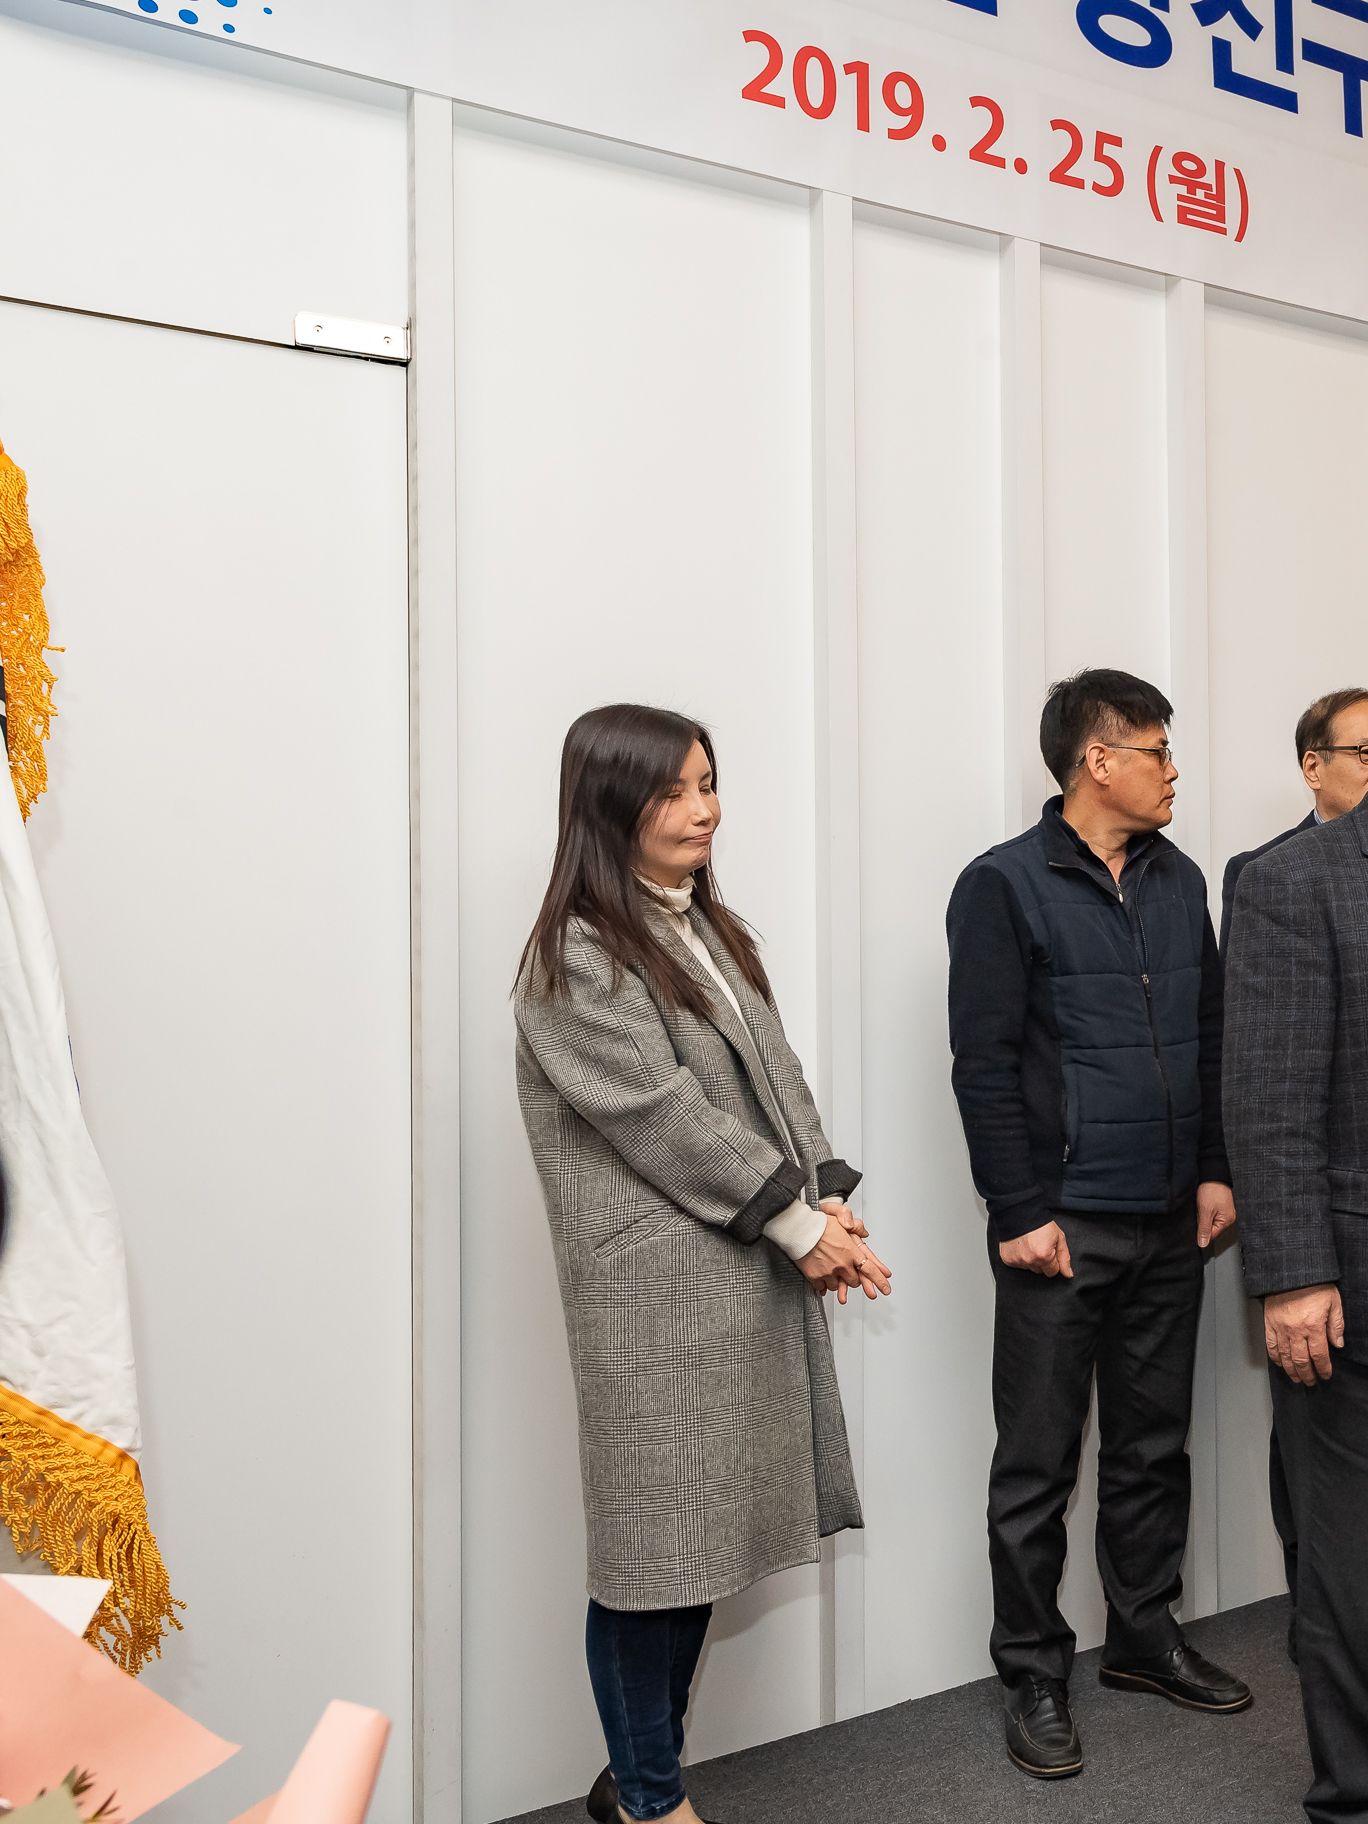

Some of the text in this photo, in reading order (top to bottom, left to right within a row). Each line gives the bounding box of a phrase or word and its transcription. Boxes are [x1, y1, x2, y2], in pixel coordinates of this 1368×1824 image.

[741, 29, 1249, 243] 2019. 2. 25 (월)
